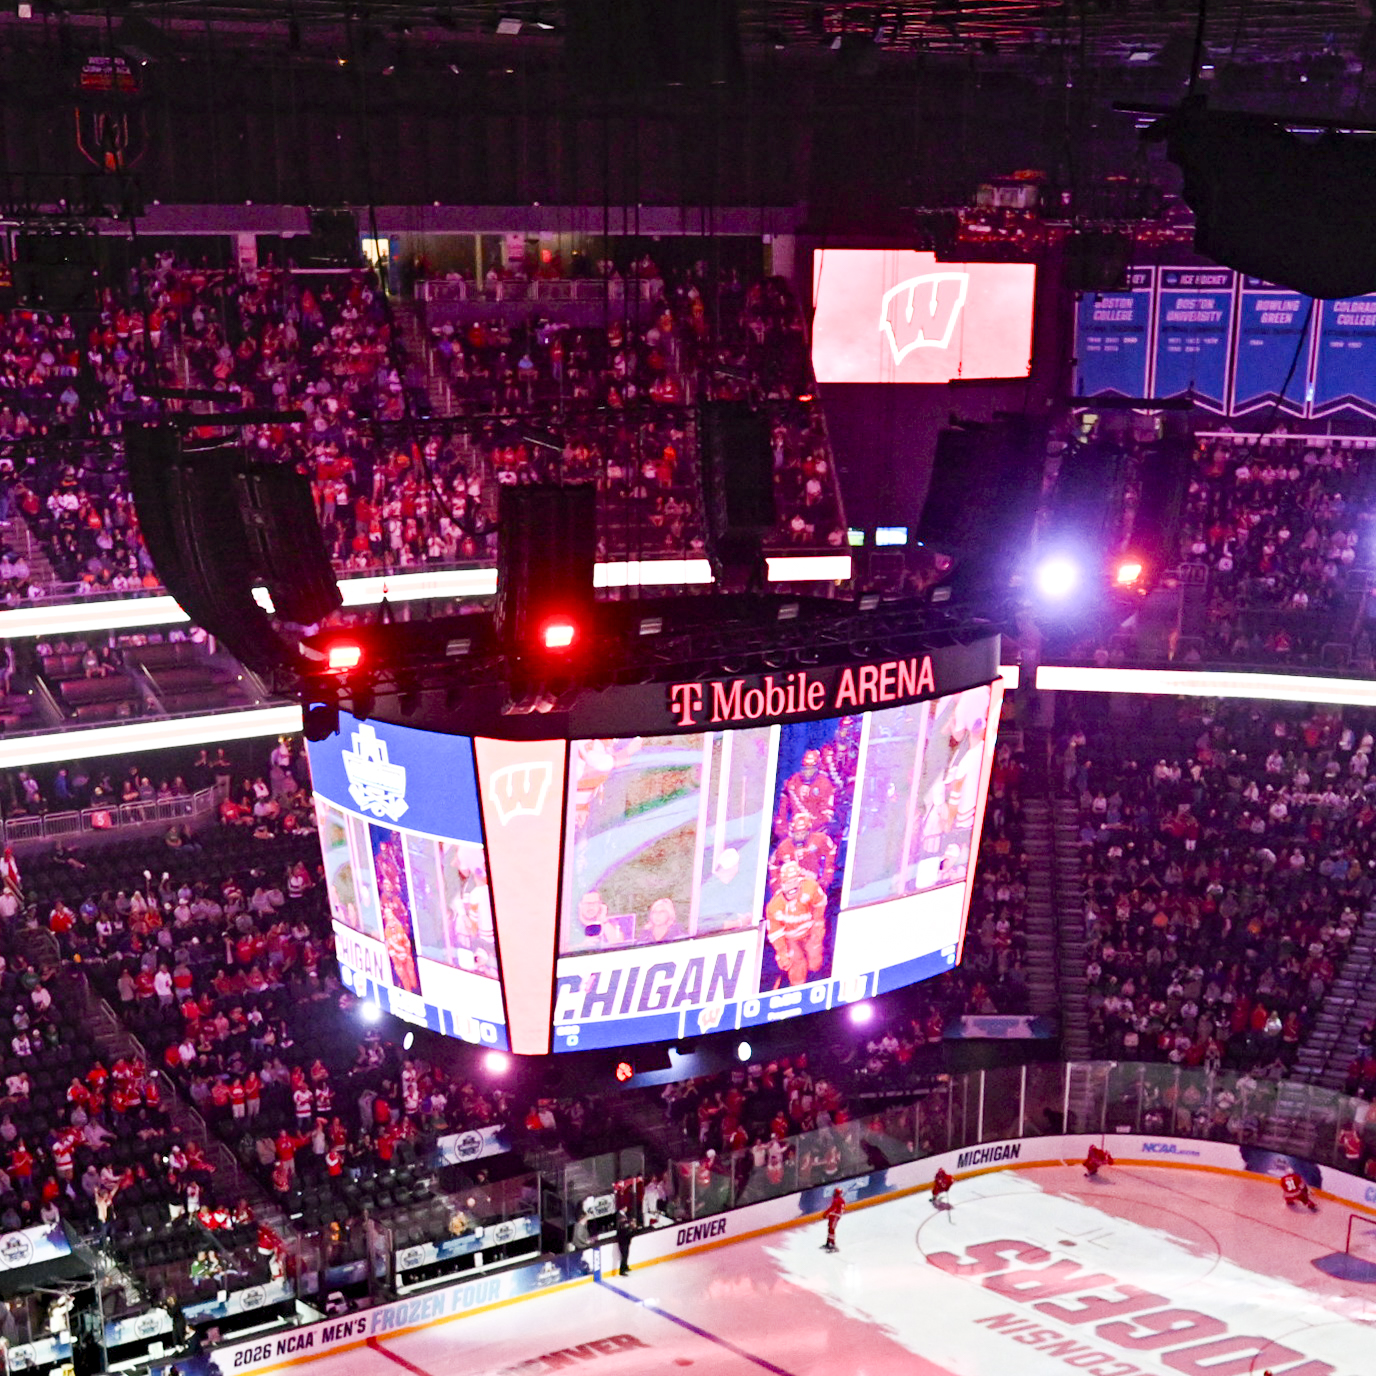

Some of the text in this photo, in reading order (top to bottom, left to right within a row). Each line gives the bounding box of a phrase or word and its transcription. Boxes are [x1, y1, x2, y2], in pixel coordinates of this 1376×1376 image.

[1093, 310, 1134, 321] COLLEGE
[1261, 312, 1294, 324] GREEN
[711, 672, 825, 723] Mobile
[835, 655, 936, 709] ARENA
[957, 1144, 1021, 1169] MICHIGAN
[677, 1218, 727, 1246] DENVER
[234, 1343, 272, 1367] 2026
[322, 1317, 366, 1344] MEN'S
[371, 1294, 445, 1334] FROZEN
[452, 1278, 501, 1313] FOUR
